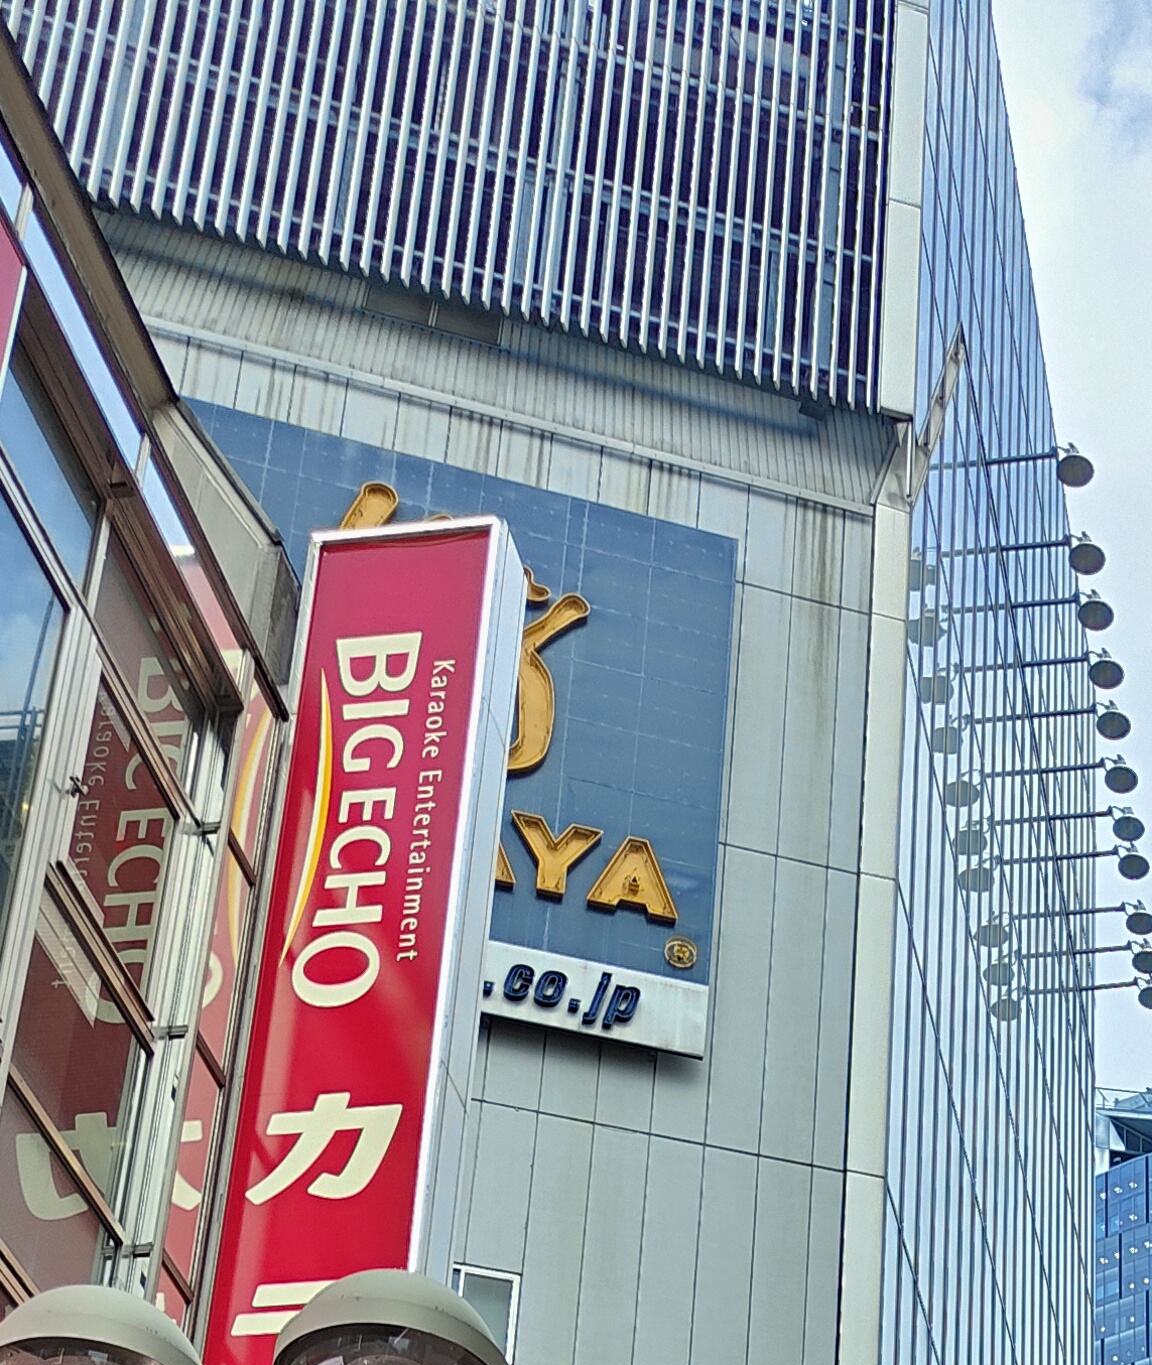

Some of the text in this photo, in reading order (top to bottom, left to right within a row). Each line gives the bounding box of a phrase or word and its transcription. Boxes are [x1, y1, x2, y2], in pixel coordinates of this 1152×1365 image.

[291, 632, 423, 1008] BIG ECHO
[396, 658, 456, 962] Karaoke Entertainment
